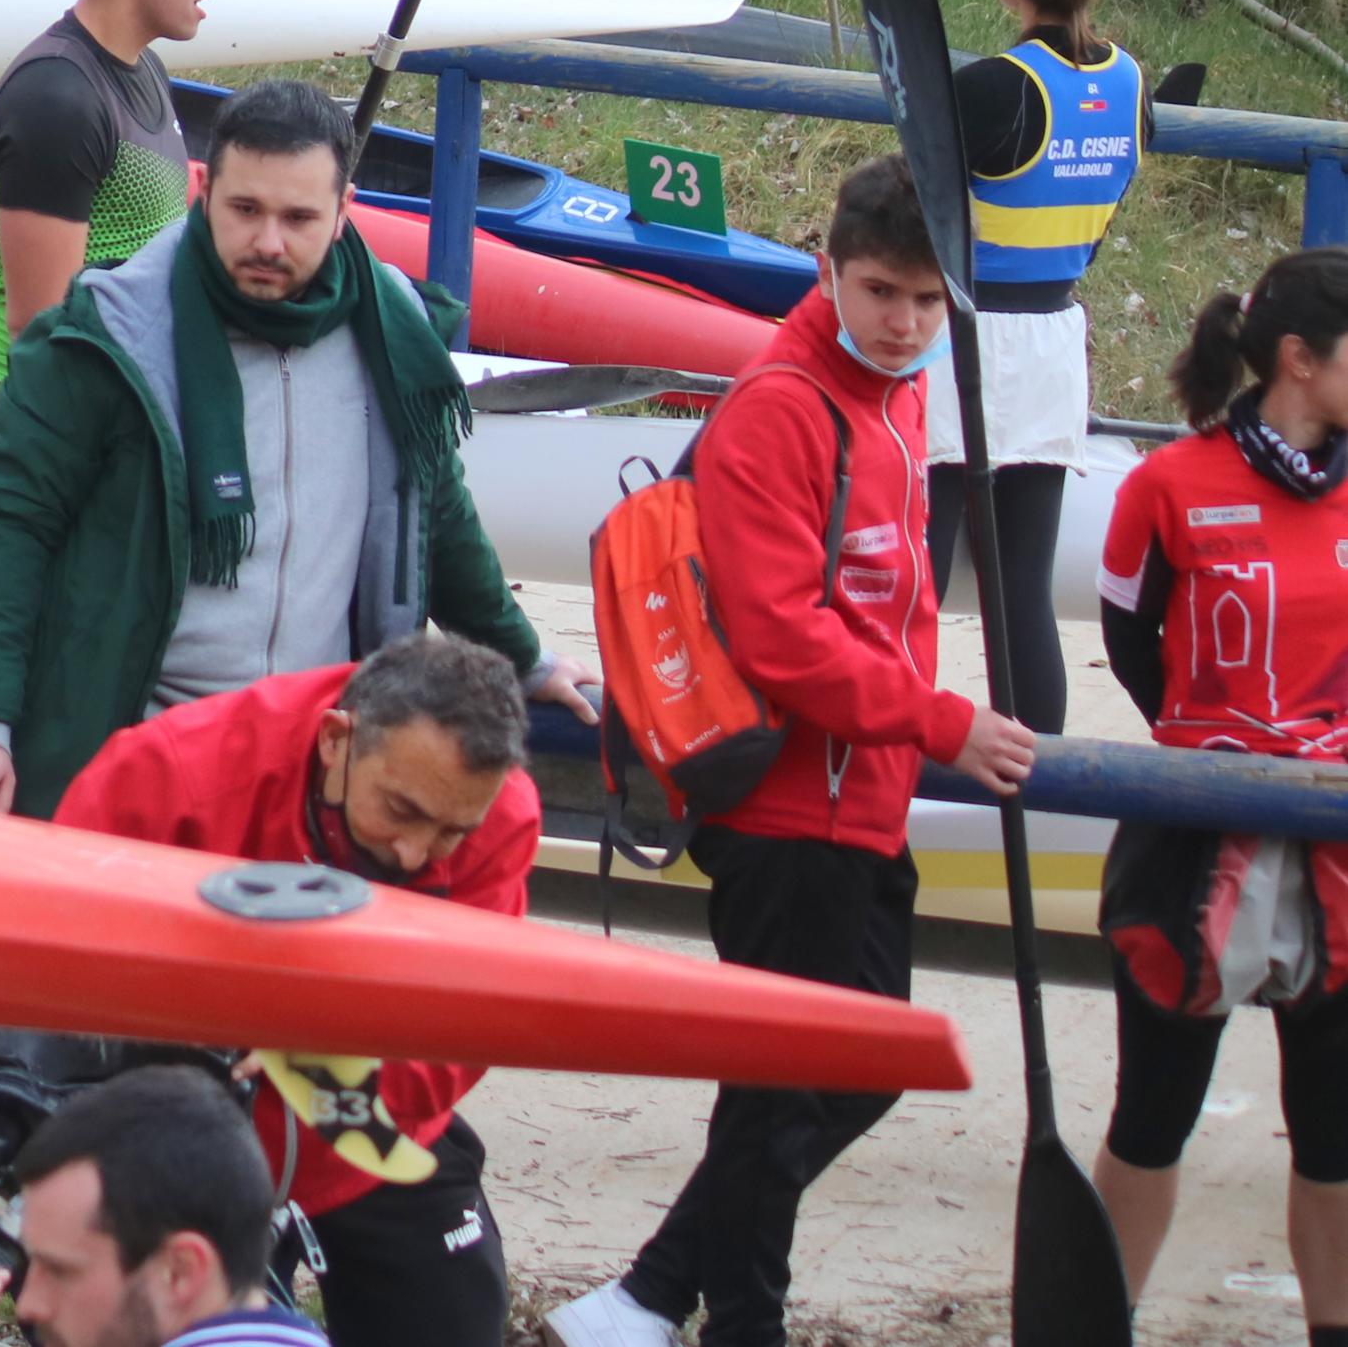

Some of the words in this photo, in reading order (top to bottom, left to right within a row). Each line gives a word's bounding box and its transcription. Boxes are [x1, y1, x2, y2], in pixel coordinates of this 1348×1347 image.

[1047, 138, 1077, 160] C.D.
[1081, 137, 1130, 158] CISNE
[649, 155, 701, 207] 23
[1053, 162, 1113, 178] VALLADOLID
[444, 1220, 483, 1251] PUMA
